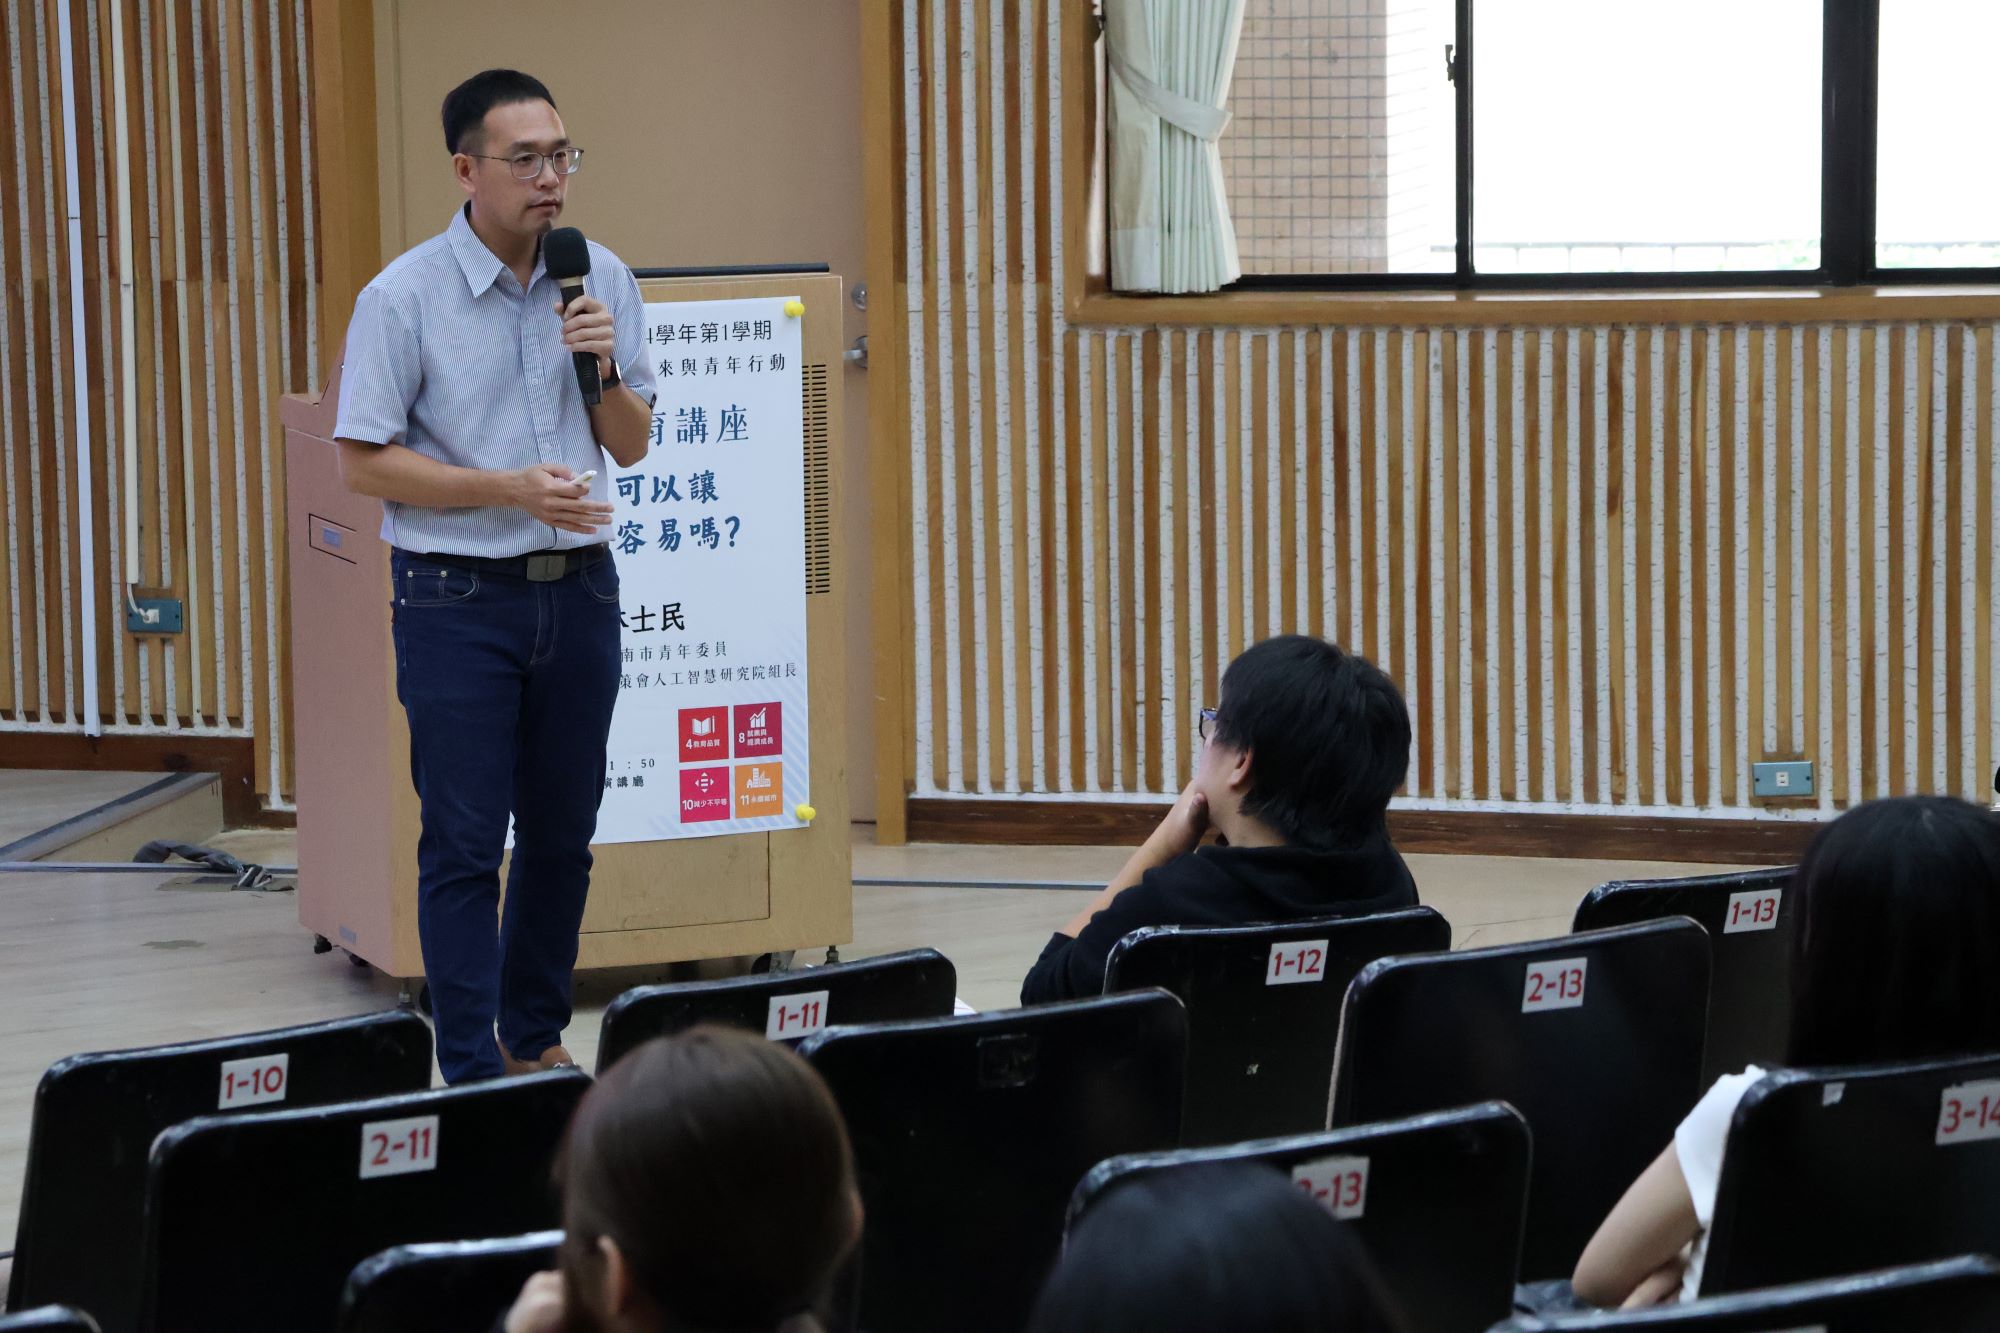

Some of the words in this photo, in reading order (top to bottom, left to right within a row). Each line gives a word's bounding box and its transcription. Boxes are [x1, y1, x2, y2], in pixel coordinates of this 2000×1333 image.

[658, 353, 785, 378] 來與青年行動
[615, 469, 719, 506] 可以讓
[617, 515, 741, 555] 容易嗎?
[621, 641, 727, 663] 南市青年委員
[620, 662, 797, 690] 策會人工智慧研究院組長
[1731, 897, 1776, 924] 1-13
[1273, 949, 1321, 976] 1-12
[1528, 969, 1583, 1003] 2-13
[776, 1002, 820, 1031] 1-11
[225, 1066, 284, 1100] 1-10
[1943, 1096, 2000, 1134] 3-14
[370, 1128, 431, 1166] 2-11
